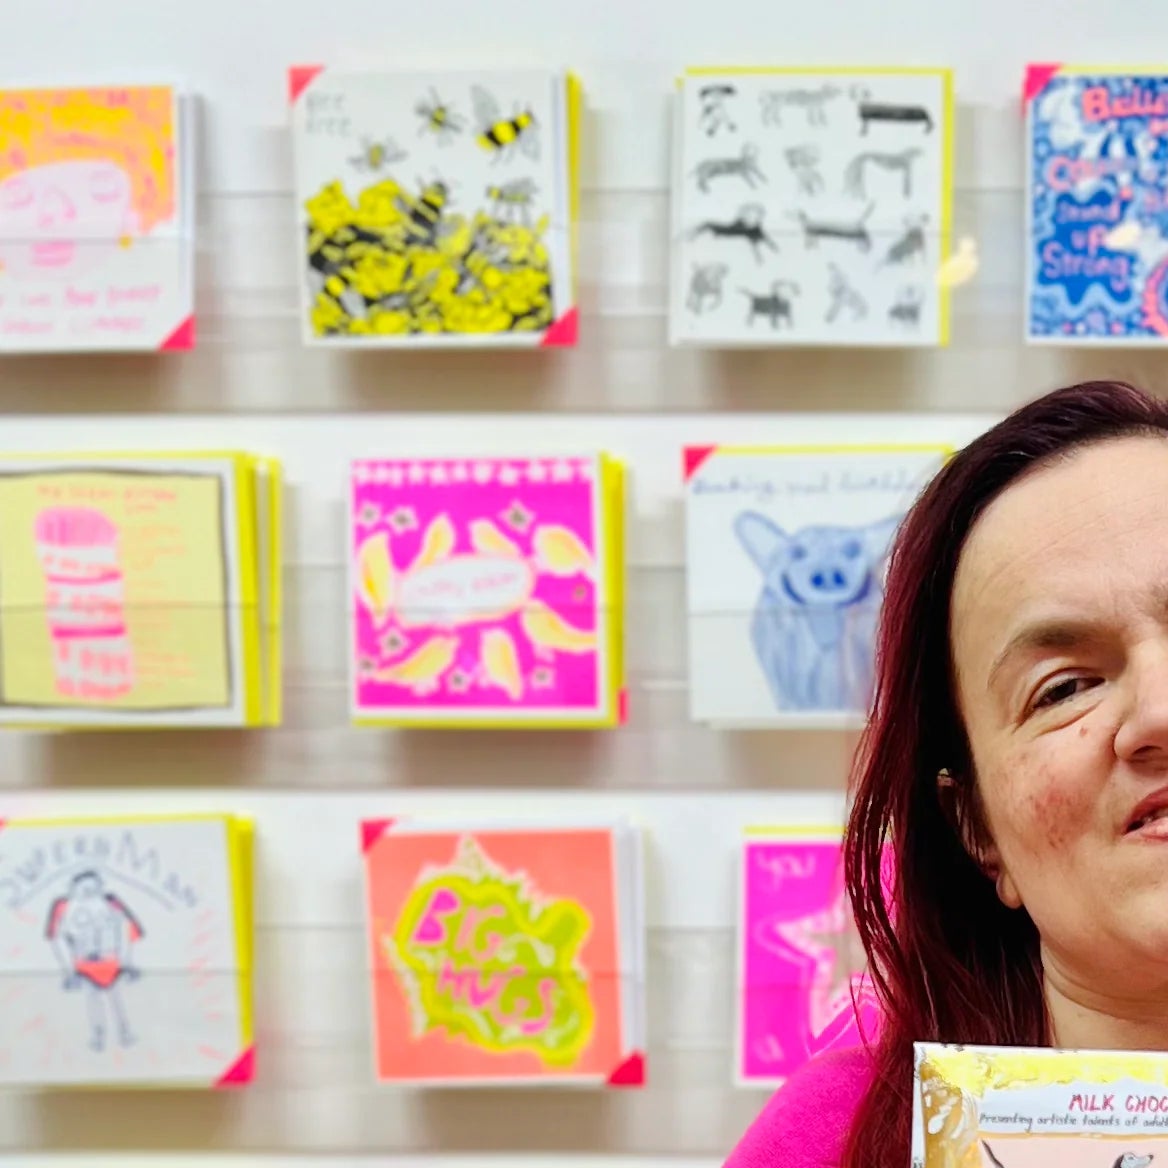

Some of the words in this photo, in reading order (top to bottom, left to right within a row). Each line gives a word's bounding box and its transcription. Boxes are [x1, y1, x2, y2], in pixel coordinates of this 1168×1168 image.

[1069, 1094, 1114, 1111] MILK
[979, 1113, 1033, 1133] Presenting
[1037, 1115, 1077, 1126] artistic
[1082, 1115, 1120, 1127] talents
